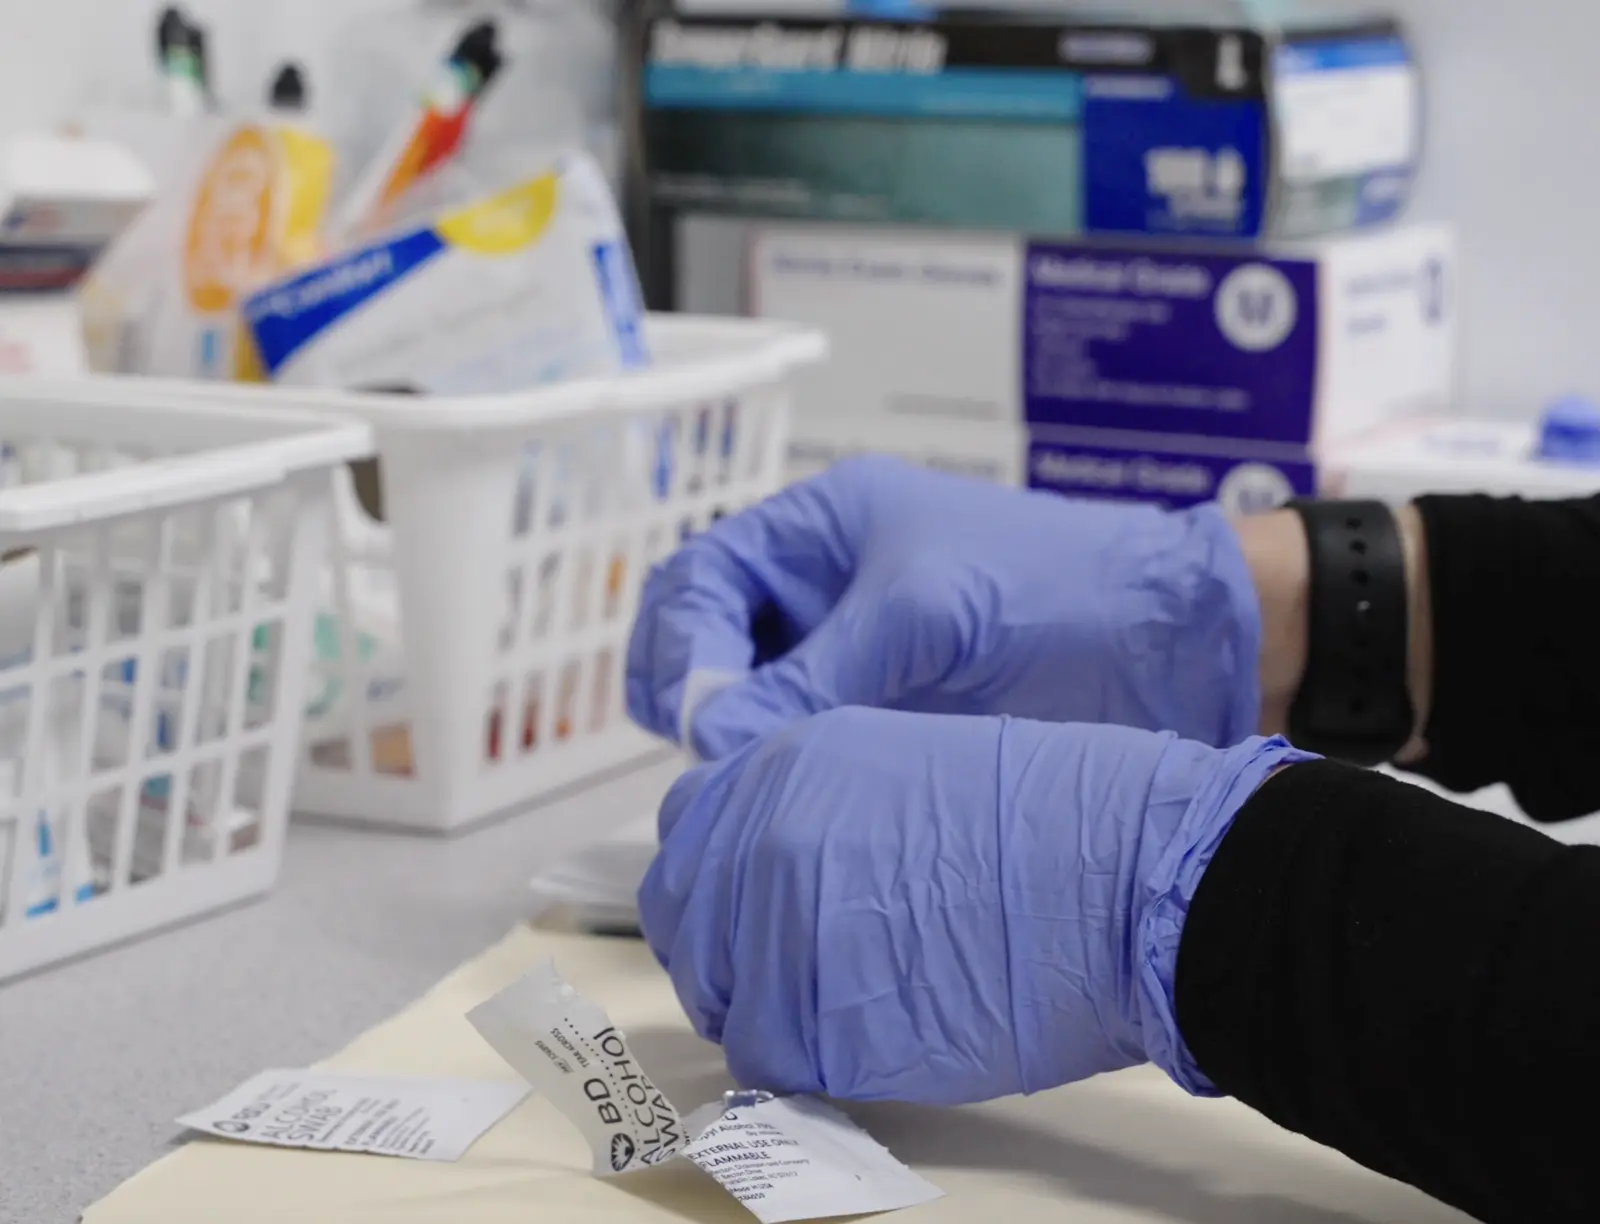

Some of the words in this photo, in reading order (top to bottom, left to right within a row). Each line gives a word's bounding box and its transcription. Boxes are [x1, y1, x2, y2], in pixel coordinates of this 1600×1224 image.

[550, 1028, 574, 1051] ACROSS
[573, 1050, 590, 1068] TEAR
[583, 1078, 623, 1124] BD
[687, 1141, 748, 1160] EXTERNAL
[747, 1139, 773, 1149] USE
